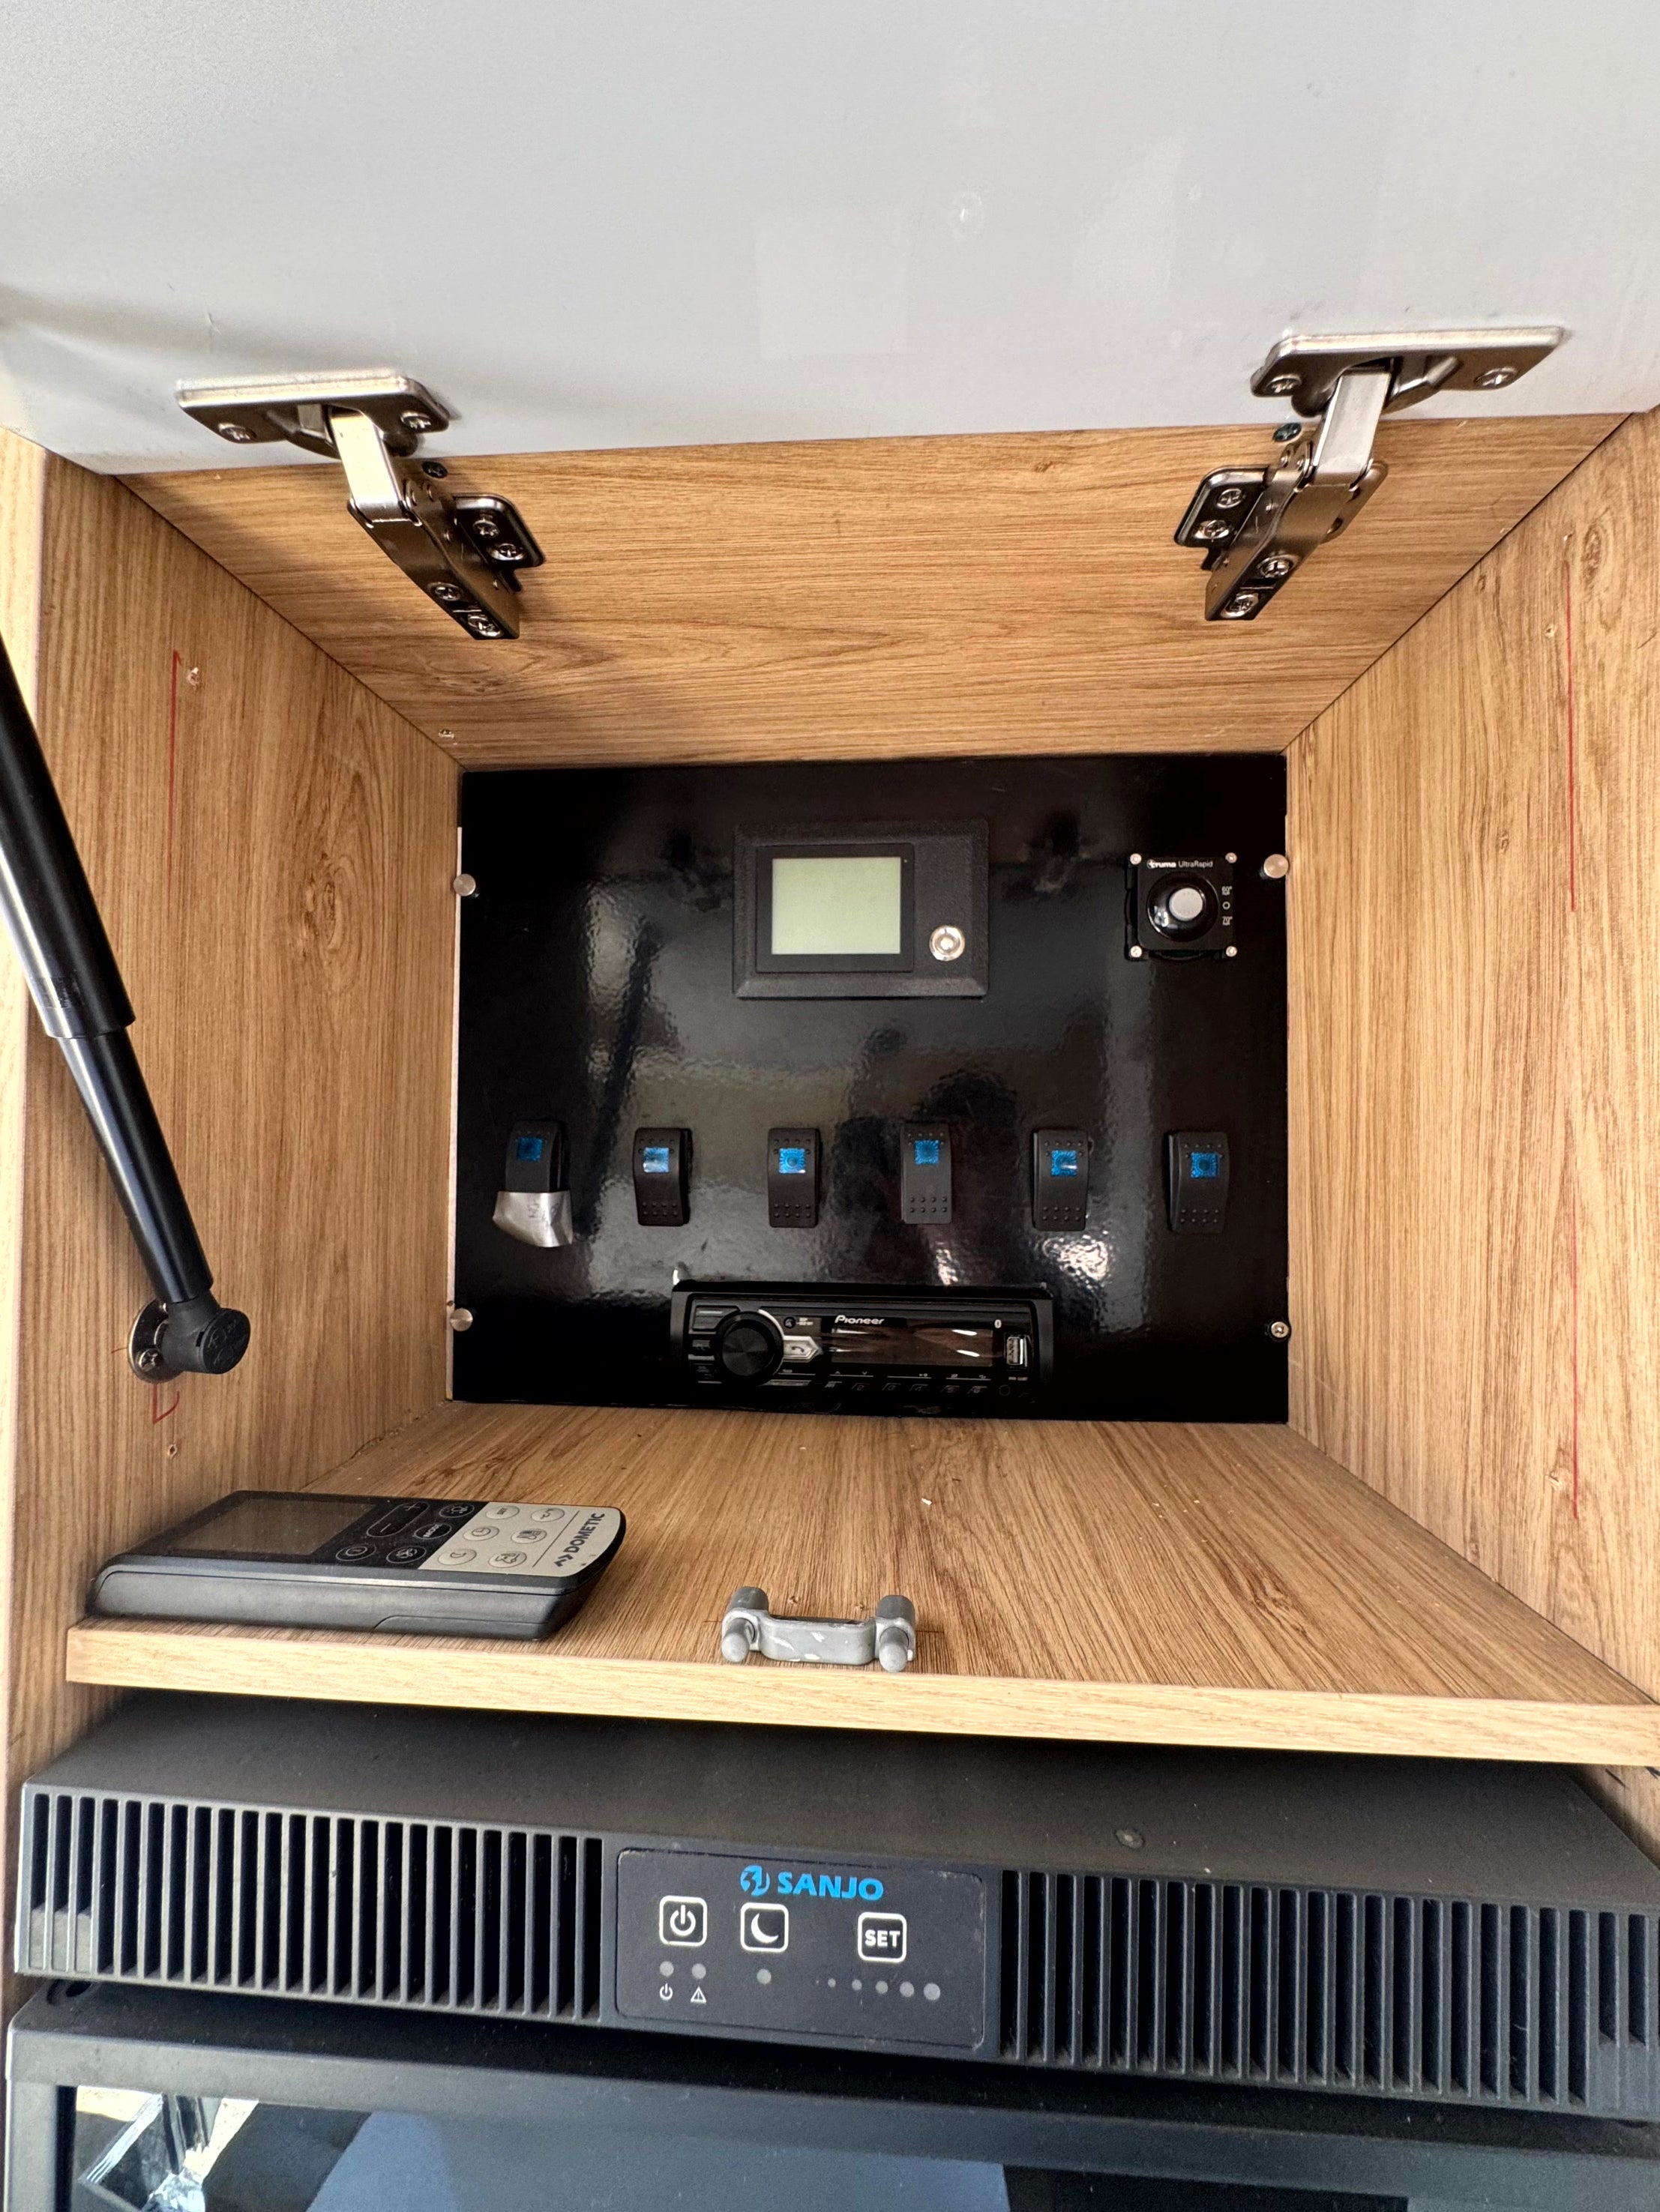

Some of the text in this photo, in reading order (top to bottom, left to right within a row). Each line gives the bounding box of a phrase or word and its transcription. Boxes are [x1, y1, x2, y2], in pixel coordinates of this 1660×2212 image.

[1148, 860, 1213, 869] truma UltraRapid
[834, 1314, 885, 1325] Pioneer
[567, 1513, 605, 1553] DOMETIC
[777, 1870, 884, 1902] SANJO
[864, 1929, 901, 1948] SET
